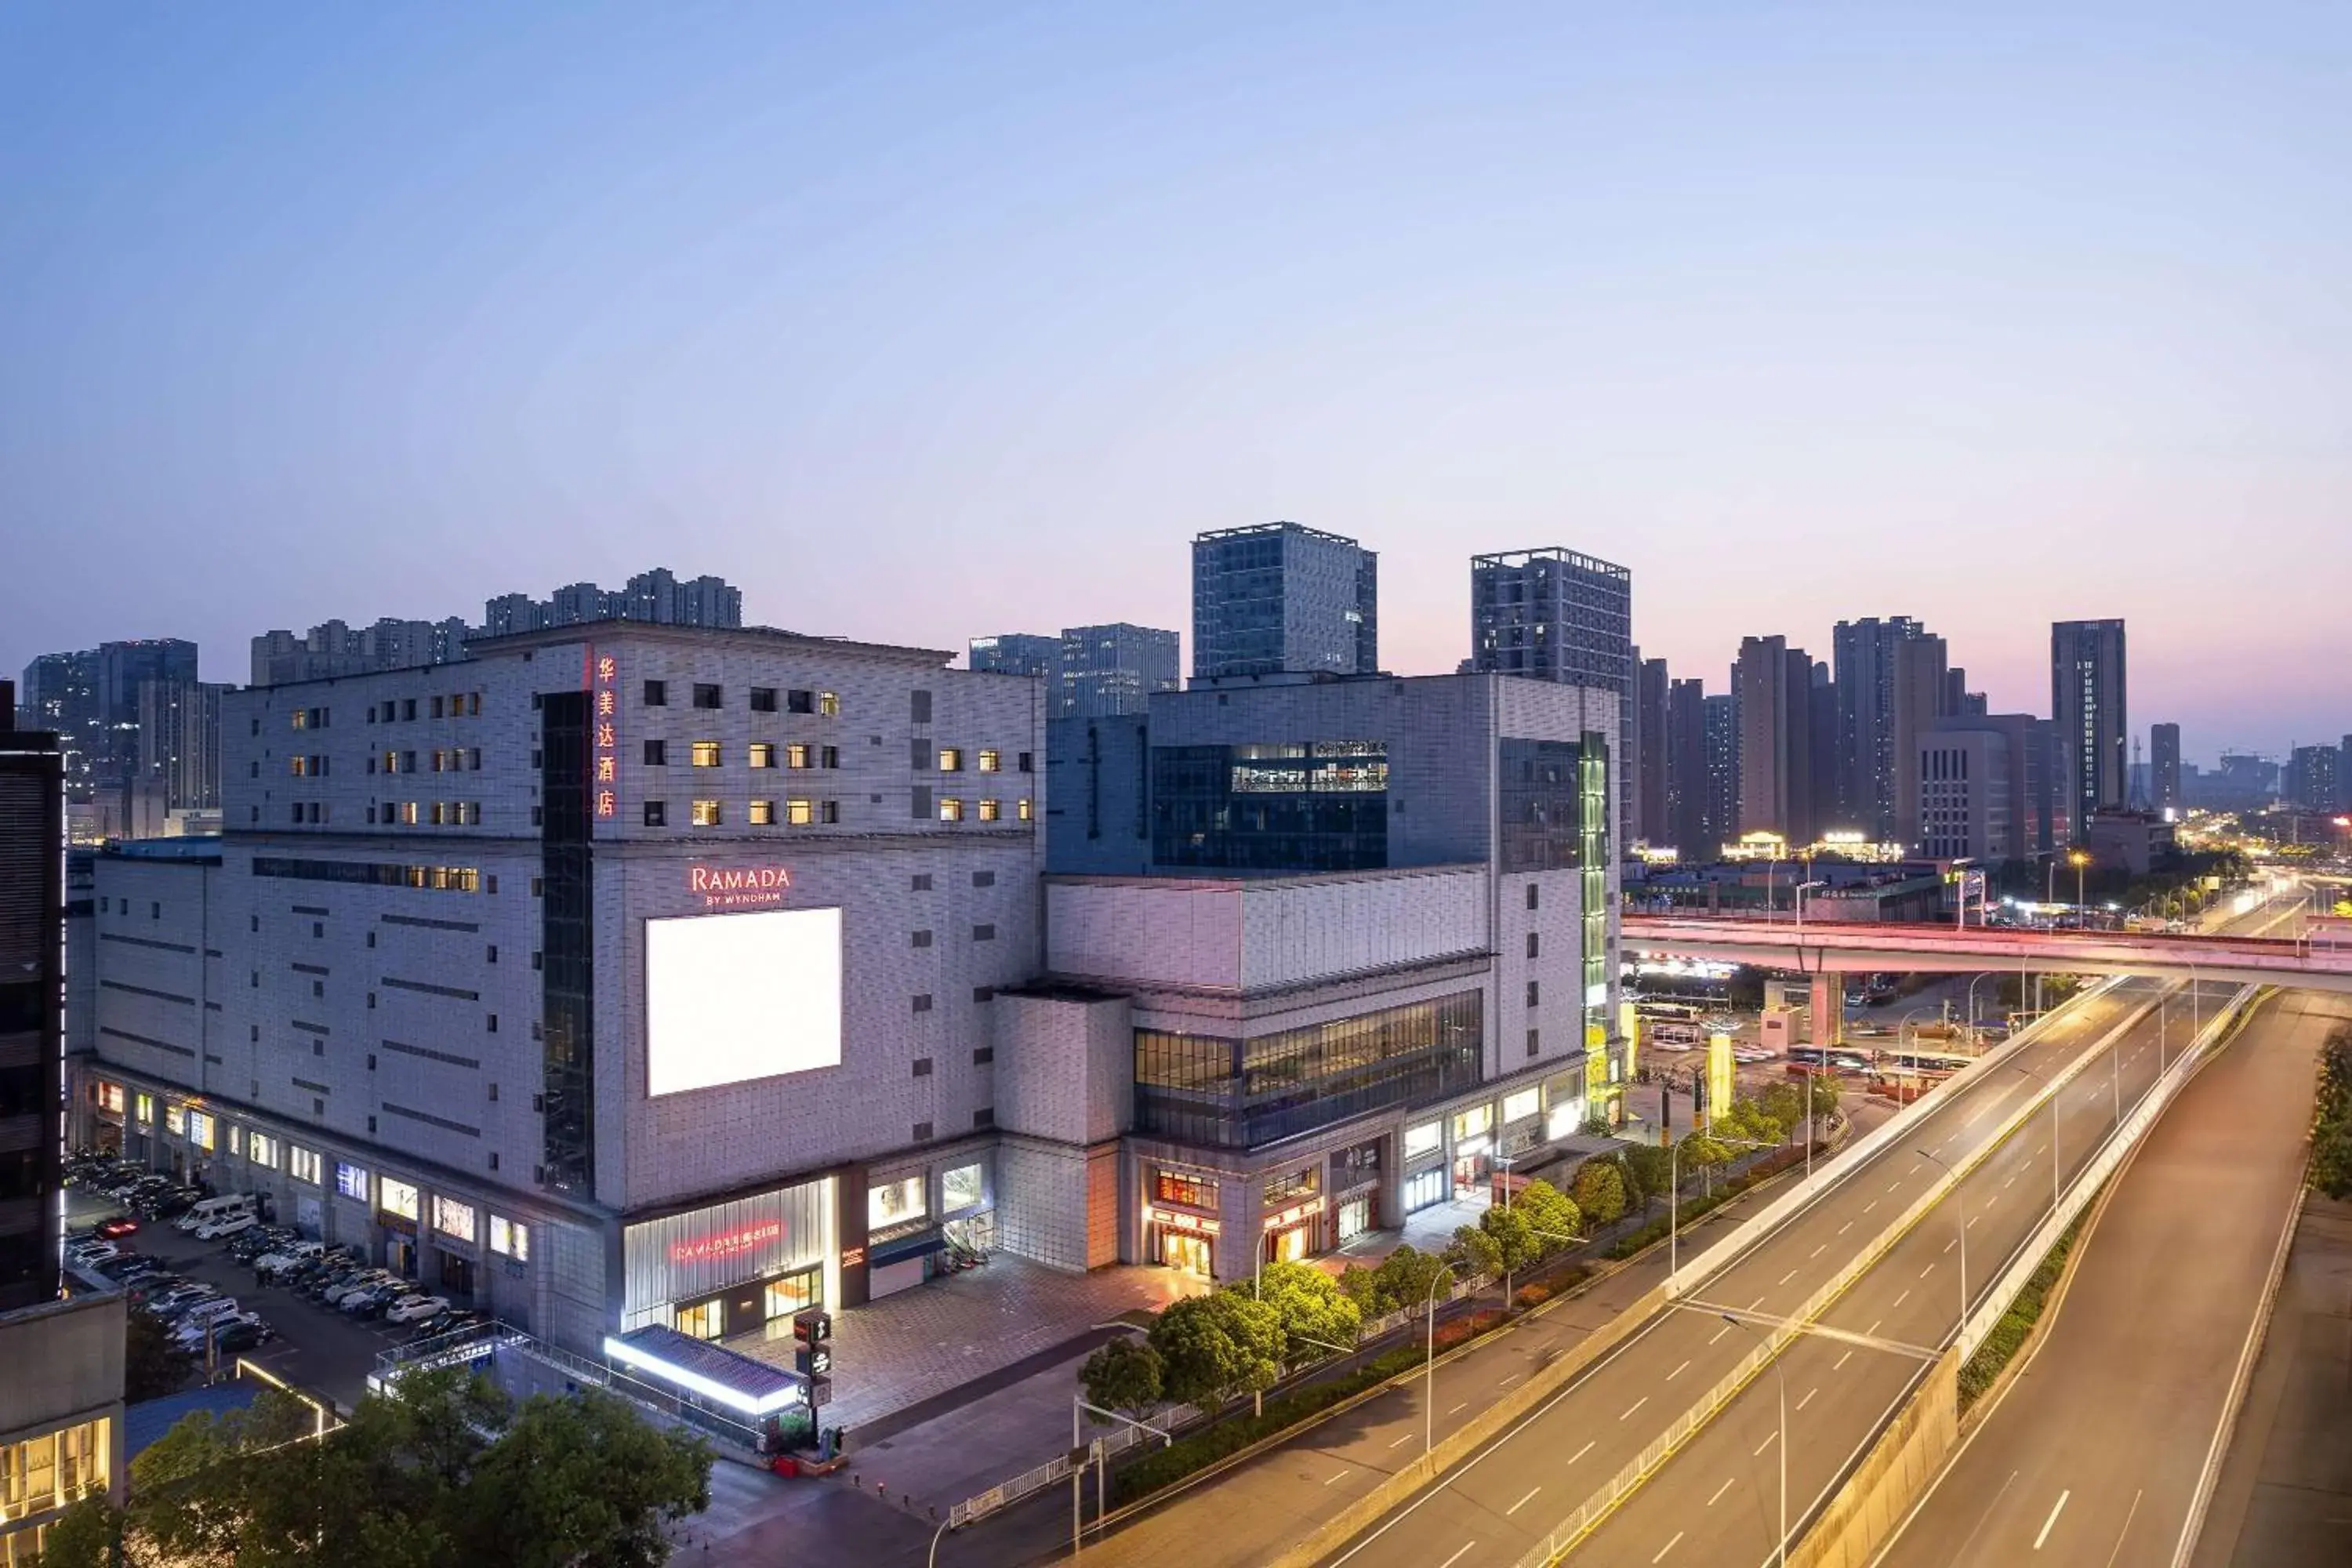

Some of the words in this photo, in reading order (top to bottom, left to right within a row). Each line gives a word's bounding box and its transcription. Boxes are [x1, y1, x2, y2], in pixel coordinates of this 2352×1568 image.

[598, 657, 615, 816] 华美达酒店
[692, 868, 789, 891] RAMADA
[706, 896, 720, 906] BY
[725, 893, 780, 904] WYNDHAM
